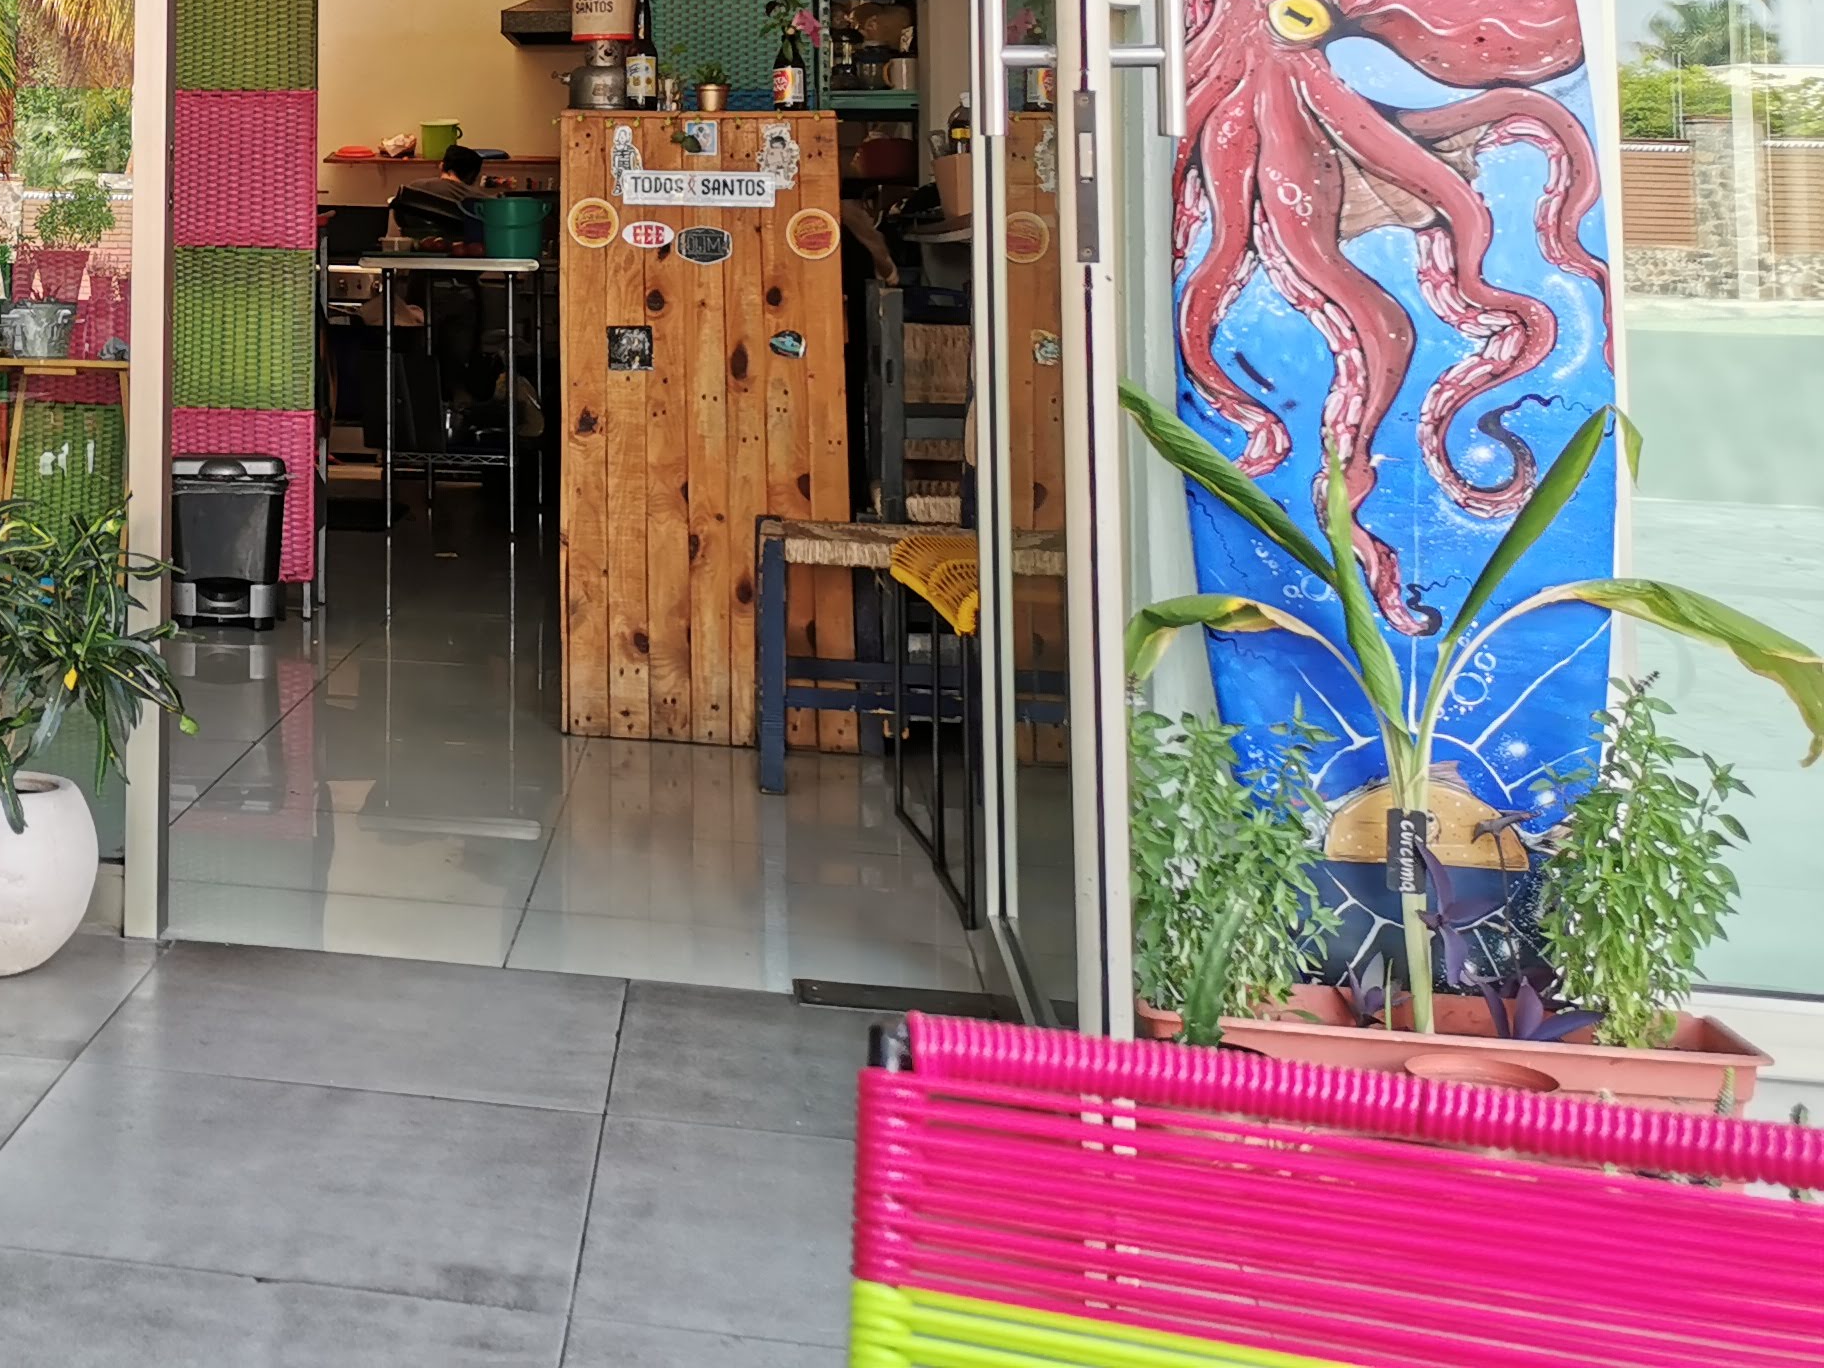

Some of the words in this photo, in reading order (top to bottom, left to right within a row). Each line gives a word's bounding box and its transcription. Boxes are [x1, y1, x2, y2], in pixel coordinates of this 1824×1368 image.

[575, 0, 614, 15] SANTOS
[630, 175, 684, 195] TODOS
[700, 177, 767, 197] SANTOS
